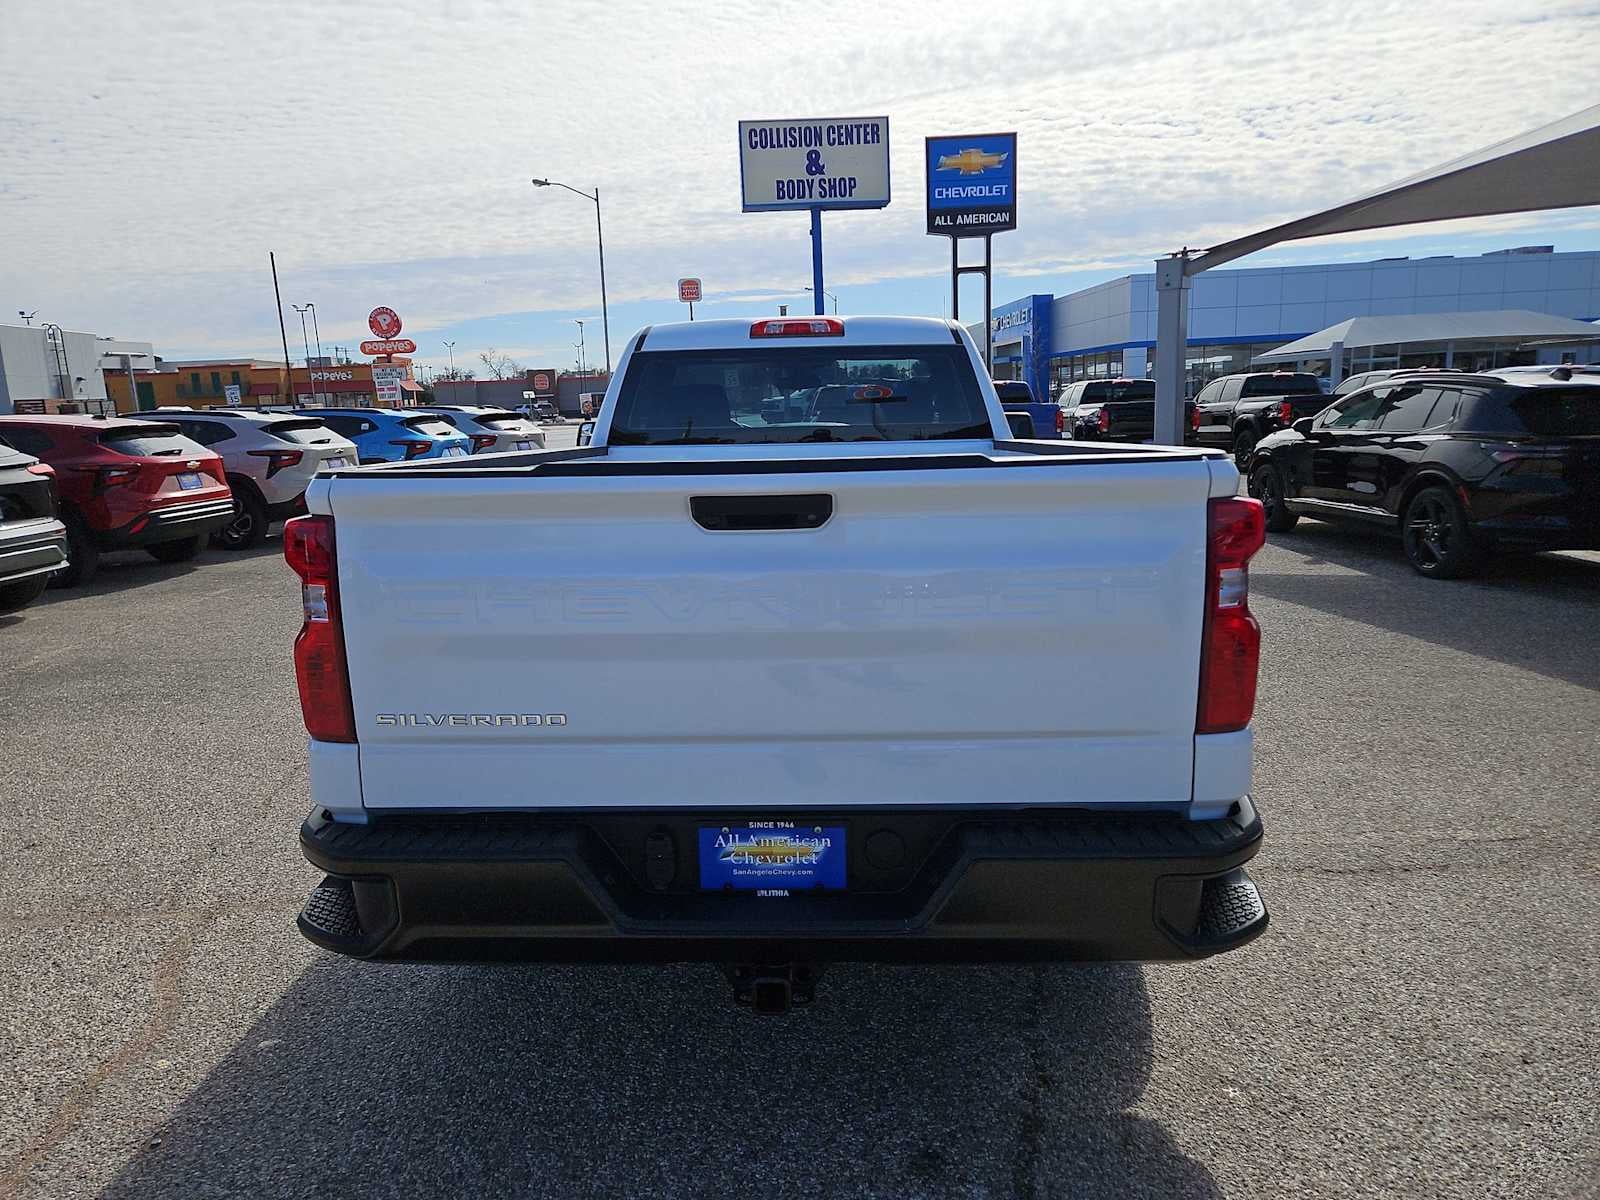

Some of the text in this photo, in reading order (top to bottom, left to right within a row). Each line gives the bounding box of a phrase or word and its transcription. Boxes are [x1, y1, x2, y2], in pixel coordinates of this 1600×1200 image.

[748, 123, 881, 150] COLLISION CENTER
[805, 149, 825, 176] &
[776, 177, 857, 200] BODY SHOP
[934, 184, 1008, 199] CHEVROLET
[934, 212, 1009, 226] ALL AMERICAN
[364, 341, 411, 352] POPEYES
[311, 371, 353, 380] POPEYES
[375, 712, 567, 727] SILVERADO
[748, 821, 775, 829] SINCE
[714, 834, 832, 848] All American
[730, 851, 818, 865] Chevrolet
[732, 868, 814, 877] SanAngeloChevy.com
